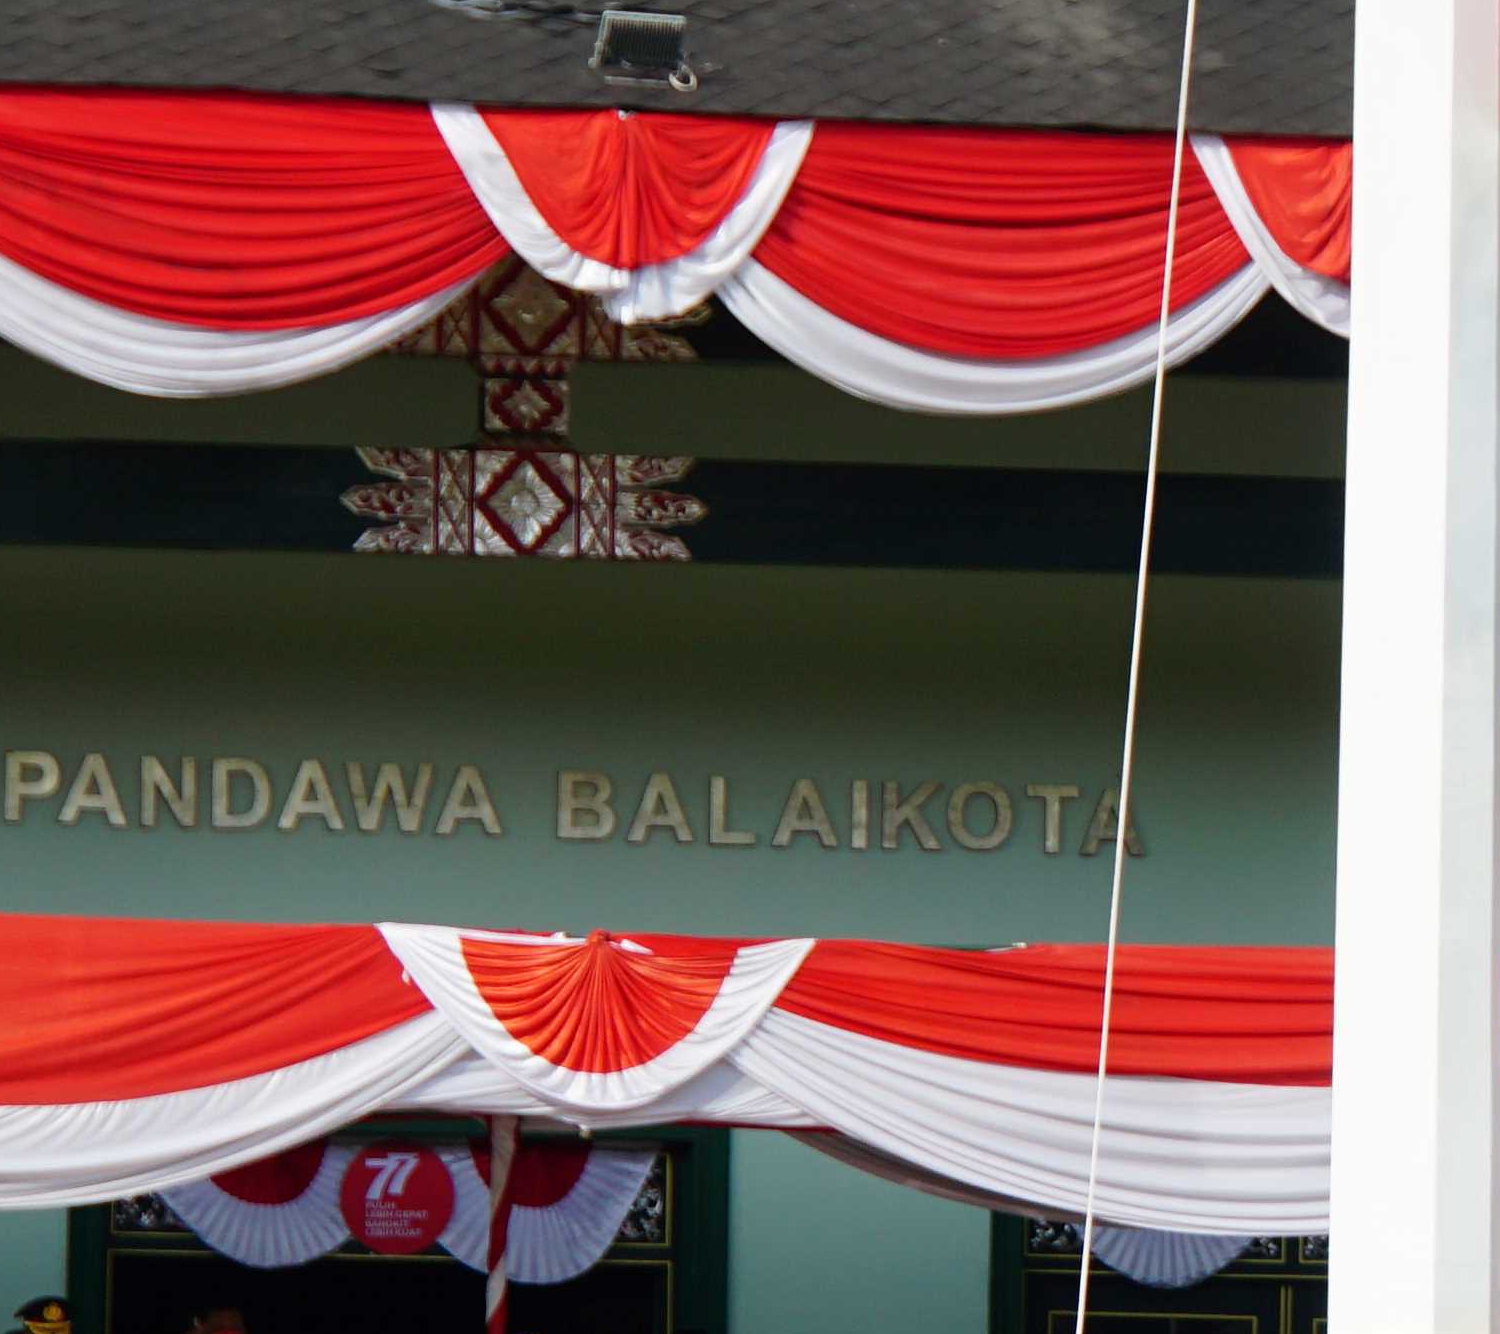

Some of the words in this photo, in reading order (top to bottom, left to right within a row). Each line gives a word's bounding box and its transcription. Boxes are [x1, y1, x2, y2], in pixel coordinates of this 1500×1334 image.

[2, 749, 502, 837] PANDAWA
[555, 770, 1146, 858] BALAIKOTA
[364, 1152, 421, 1200] 77
